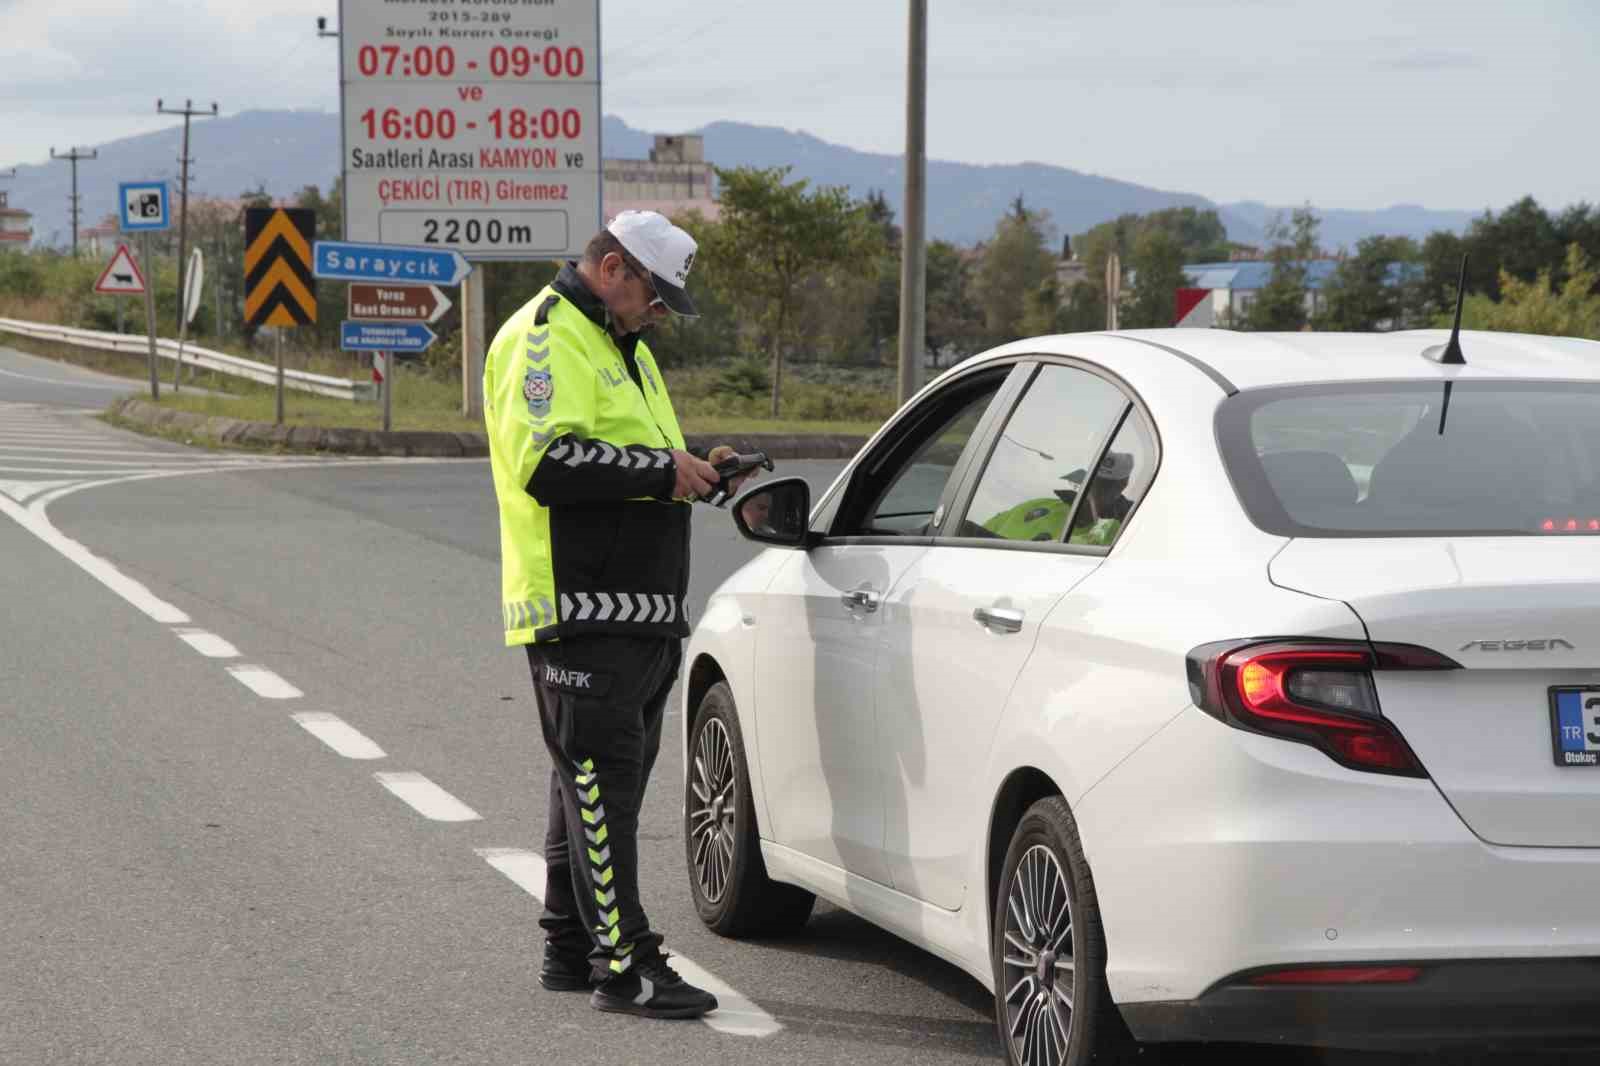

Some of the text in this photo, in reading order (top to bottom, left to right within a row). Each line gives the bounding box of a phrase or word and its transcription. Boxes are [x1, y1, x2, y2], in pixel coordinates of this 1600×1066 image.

[358, 46, 455, 76] 07:00
[489, 46, 585, 77] 09:00
[458, 87, 483, 101] ve
[361, 108, 456, 139] 16:00
[488, 108, 581, 139] 18:00
[352, 148, 583, 168] Saatleri Arası KAMYON ve
[378, 177, 568, 205] ÇEKİCİ (TIR) Giremez
[326, 251, 439, 276] Saraycık
[1562, 726, 1581, 739] TR
